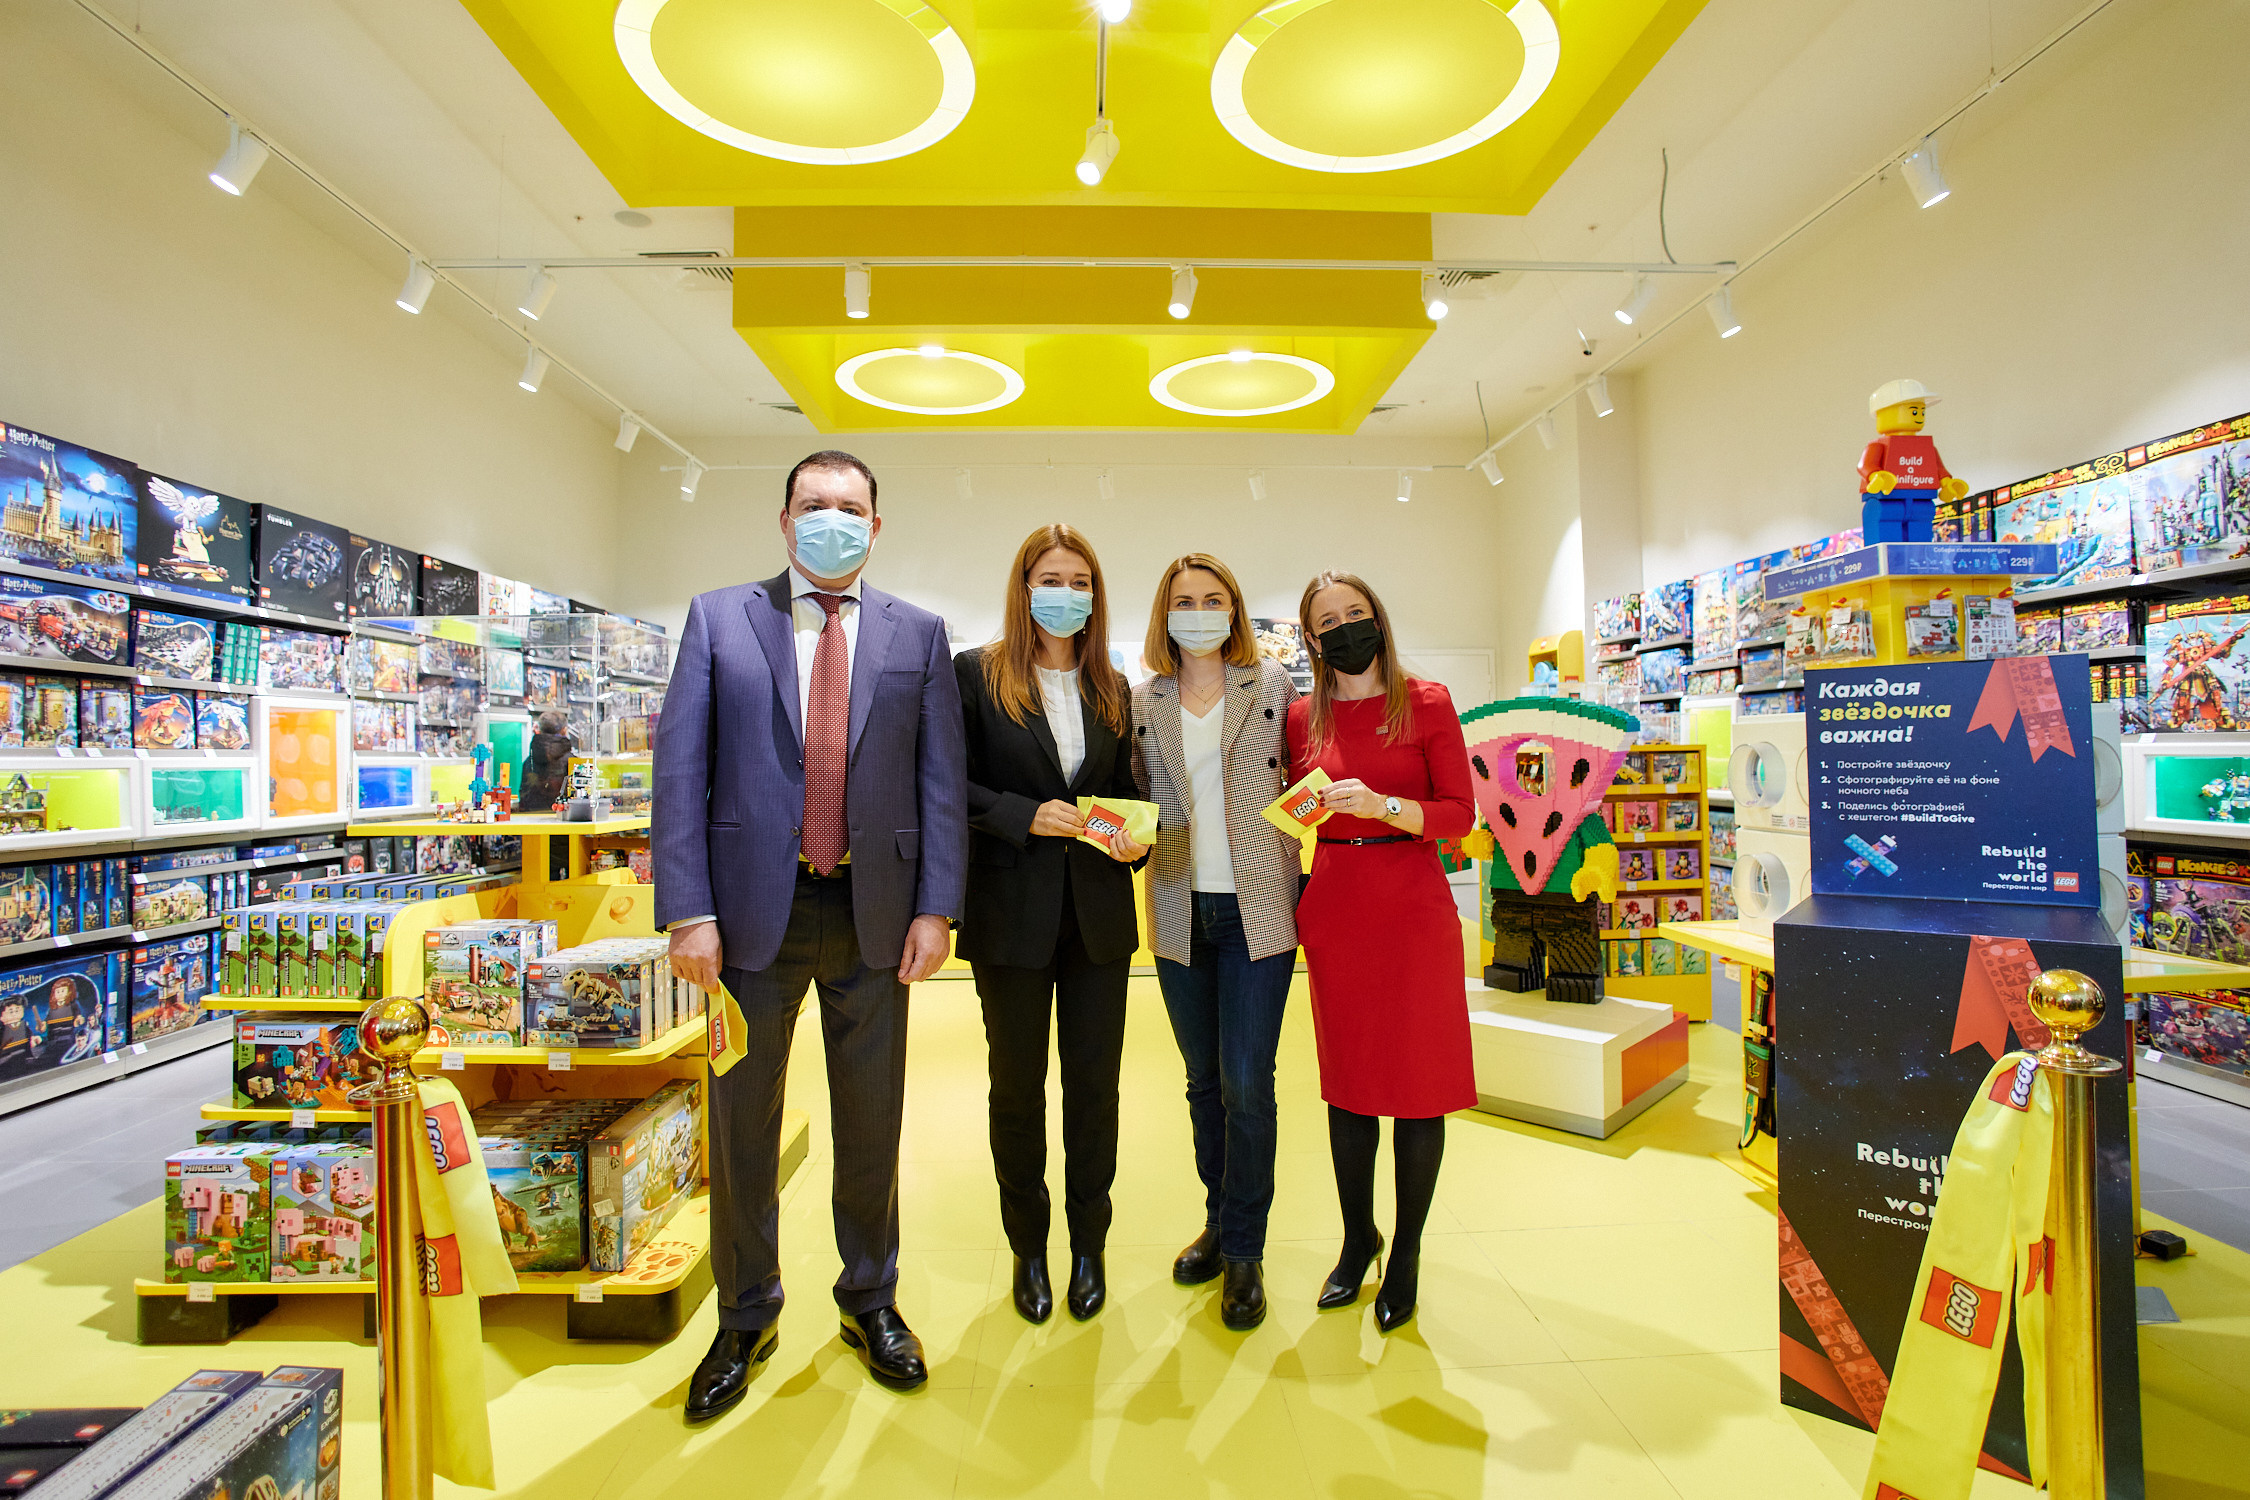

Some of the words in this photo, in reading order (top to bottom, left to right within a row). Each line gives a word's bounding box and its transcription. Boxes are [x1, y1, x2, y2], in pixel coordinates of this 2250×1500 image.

[1899, 456, 1923, 466] Build
[1907, 466, 1914, 474] a
[1818, 678, 1921, 699] Каждая
[1818, 701, 1952, 721] звёздочка
[1819, 725, 1914, 744] важна!
[1820, 761, 1829, 769] 1.
[1837, 760, 1893, 770] Постройте
[1895, 760, 1951, 770] звёздочку
[1820, 776, 1831, 784] 2.
[1837, 775, 1934, 786] Сфотографируйте
[1936, 775, 1951, 785] её
[1953, 777, 1967, 785] на
[1969, 775, 2000, 786] фоне
[1838, 787, 1881, 796] ночного
[1883, 786, 1909, 796] неба
[1292, 797, 1318, 819] LEGO
[1821, 802, 1831, 810] 3.
[1838, 801, 1888, 812] Поделись
[1891, 801, 1965, 813] фотографией
[1839, 813, 1845, 821] с
[1847, 813, 1898, 823] хештегом
[1900, 813, 1975, 824] #BuildToGive
[1086, 816, 1119, 837] LEGO
[1981, 845, 2047, 858] Rebuild
[2017, 858, 2047, 871] the
[1997, 870, 2047, 883] world
[2054, 877, 2077, 887] LEGO
[1982, 882, 2030, 891] Перестроим
[257, 1029, 304, 1039] MINECRAFT
[2010, 1055, 2040, 1108] LEGO
[1857, 1142, 1949, 1176] Rebuil
[184, 1164, 234, 1173] MINECRAFT
[1857, 1208, 1930, 1232] Перестрои
[1943, 1281, 1979, 1338] LEGO
